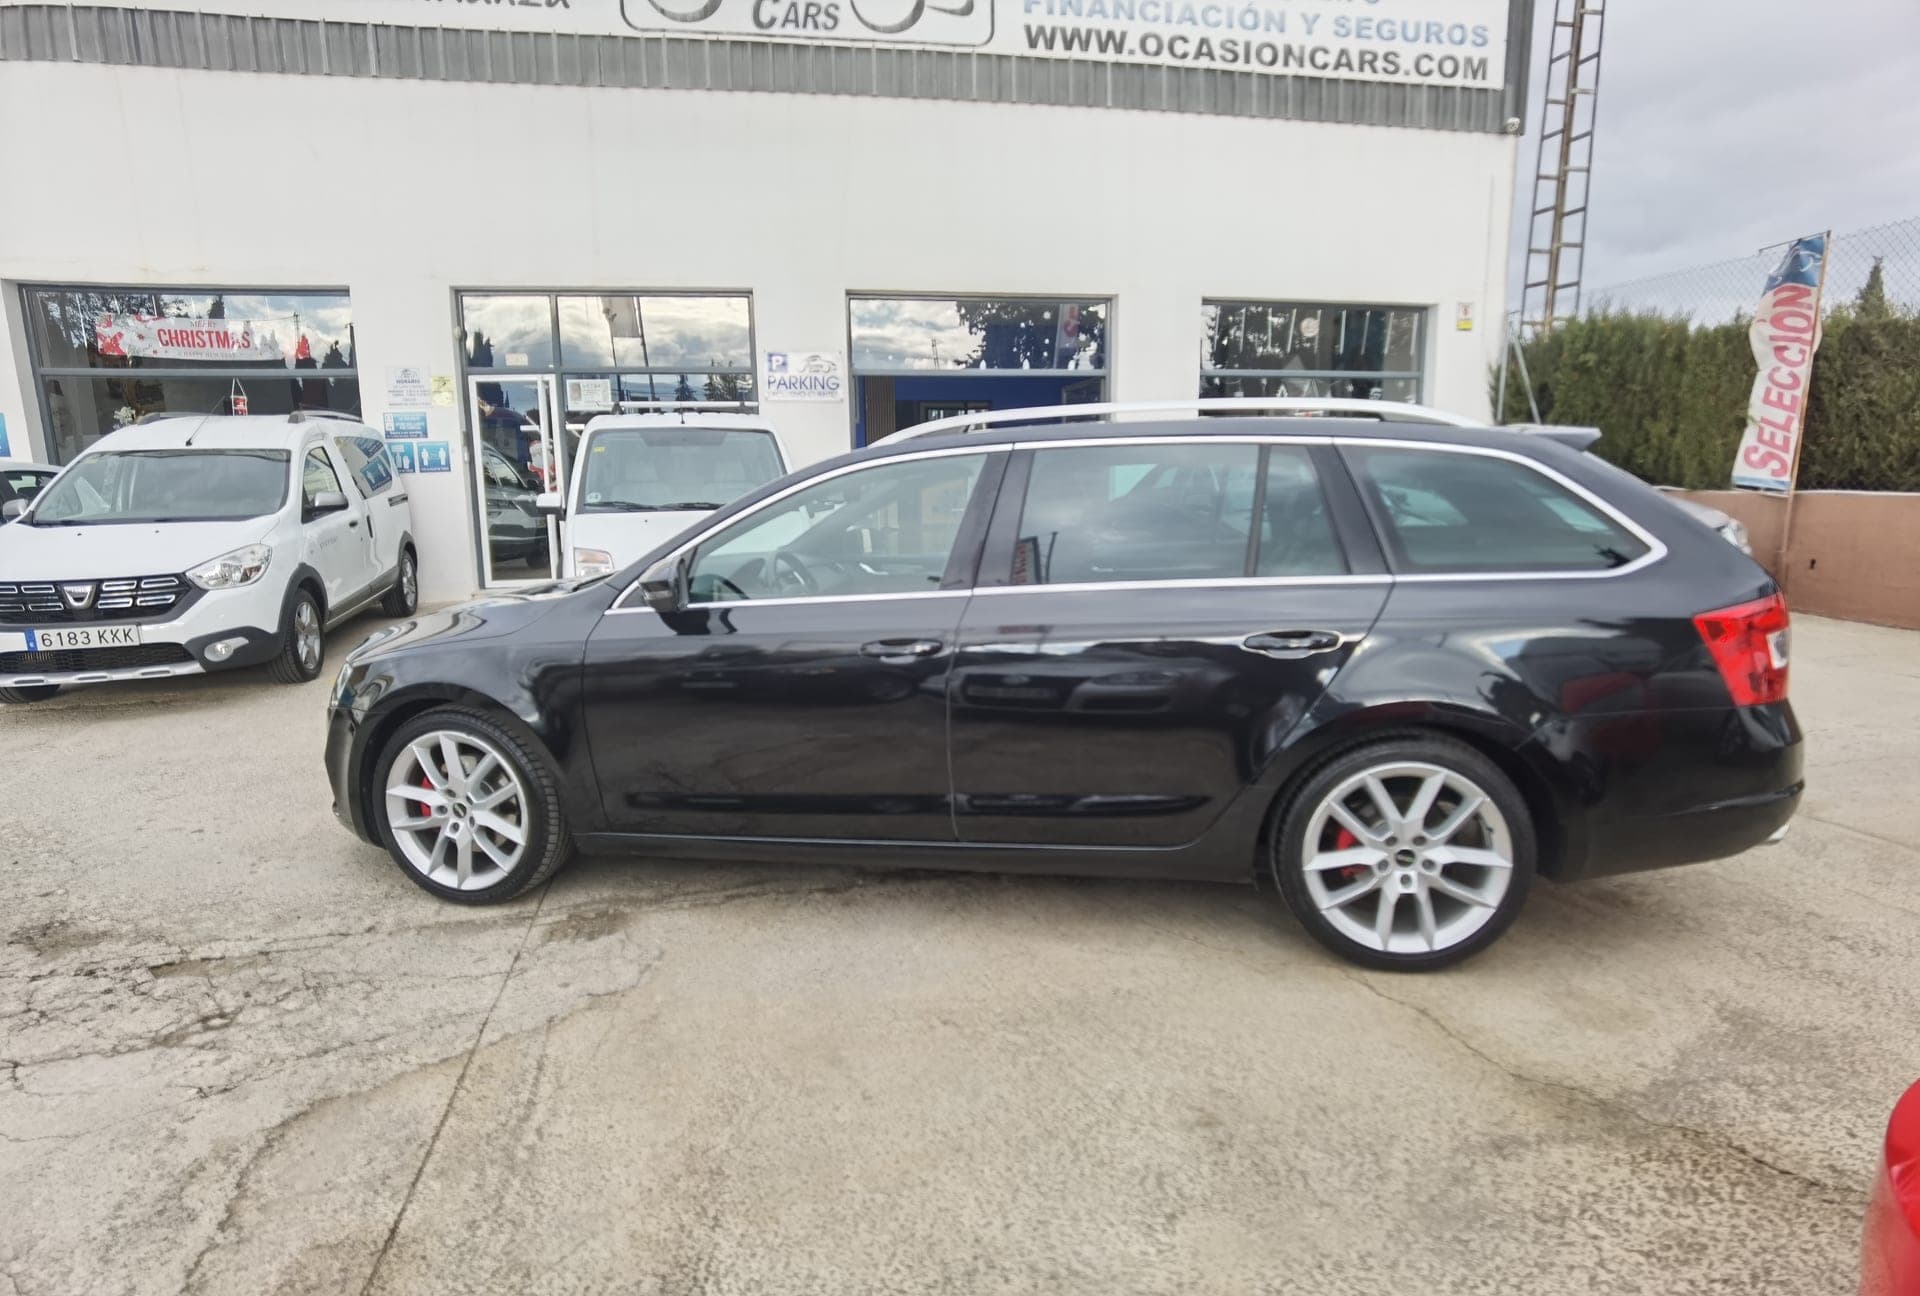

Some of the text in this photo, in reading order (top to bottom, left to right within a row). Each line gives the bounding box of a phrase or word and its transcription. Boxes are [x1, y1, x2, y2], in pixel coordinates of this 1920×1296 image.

[752, 0, 839, 30] CARS
[1023, 0, 1489, 47] FINANCIACIÓN Y SEGUROS
[1024, 23, 1489, 81] WWW.OCASIONCARS.COM
[157, 328, 251, 349] CHRISTMAS
[771, 356, 785, 371] P
[767, 375, 840, 391] PARKING
[41, 628, 134, 647] 6183 KKK
